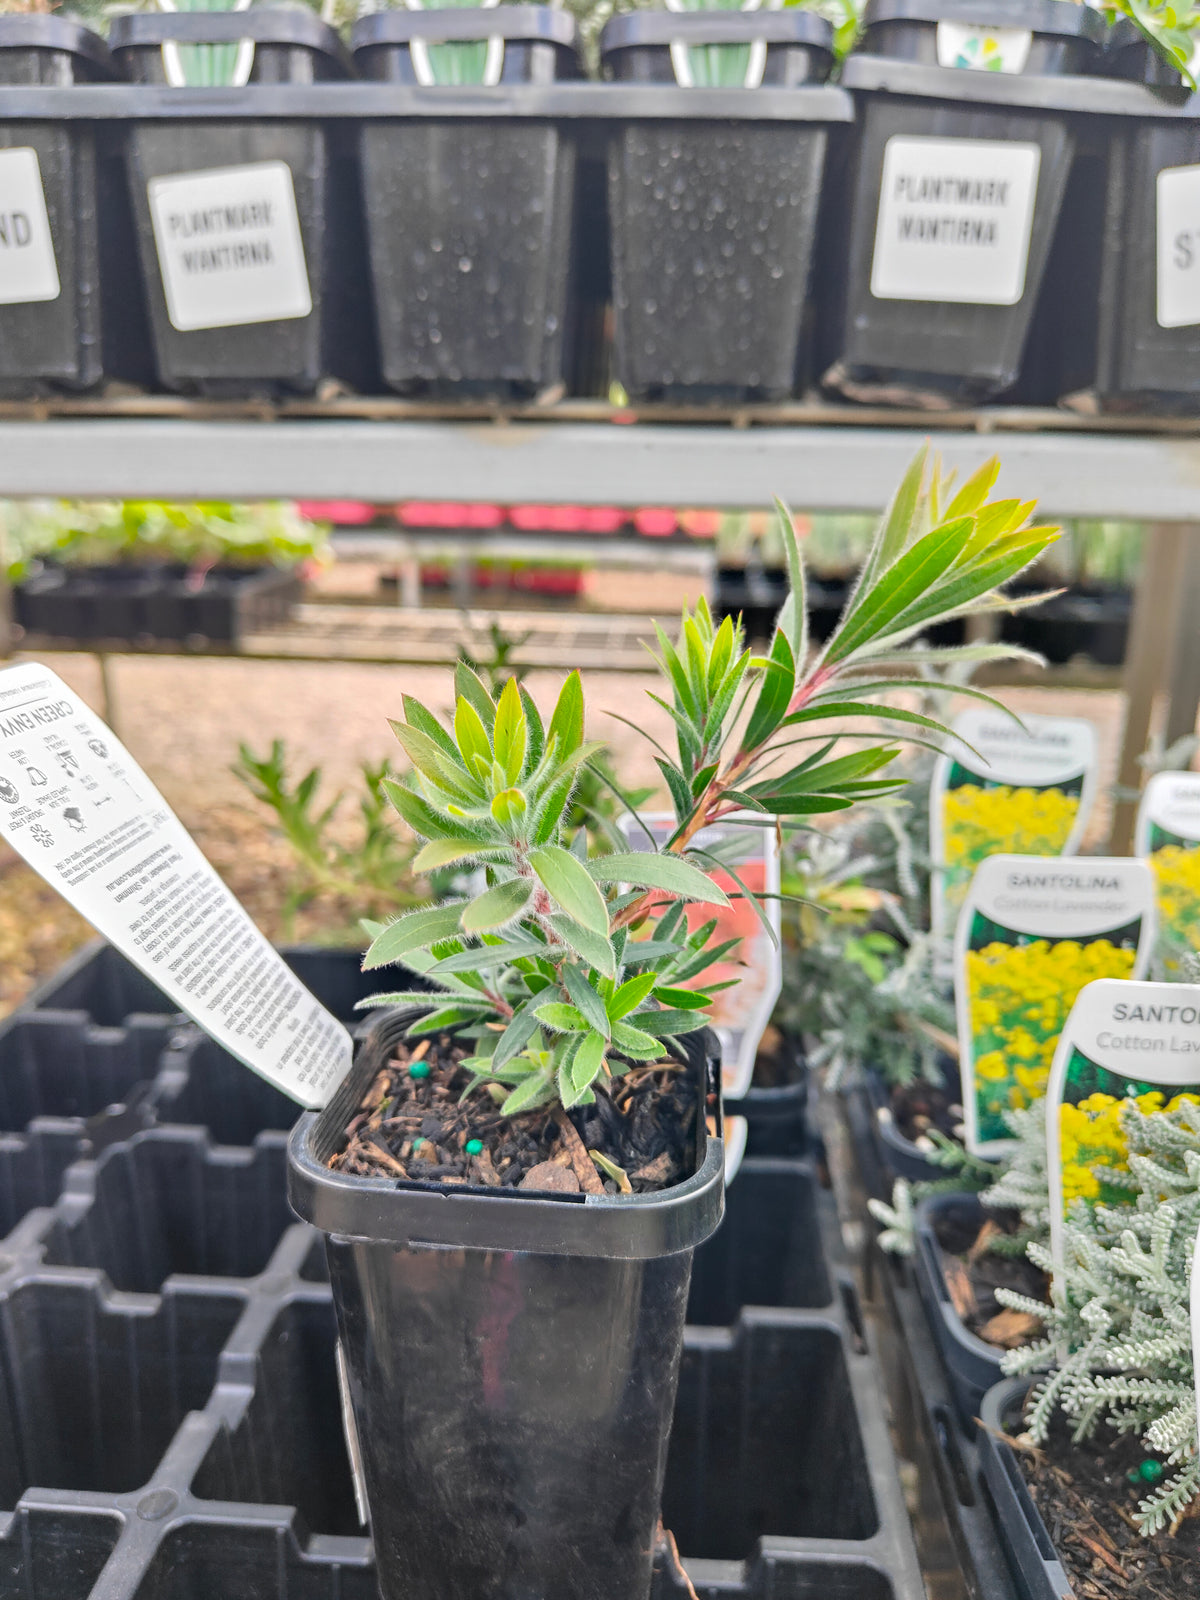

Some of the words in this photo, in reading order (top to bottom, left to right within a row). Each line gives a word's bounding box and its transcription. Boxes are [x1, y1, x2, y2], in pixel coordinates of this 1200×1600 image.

[1173, 229, 1200, 271] S
[30, 700, 73, 725] GREEN
[0, 712, 35, 737] ENVY
[1007, 872, 1121, 891] SANTOLINA
[1112, 1003, 1200, 1024] SANTO
[1096, 1031, 1164, 1051] Cotton
